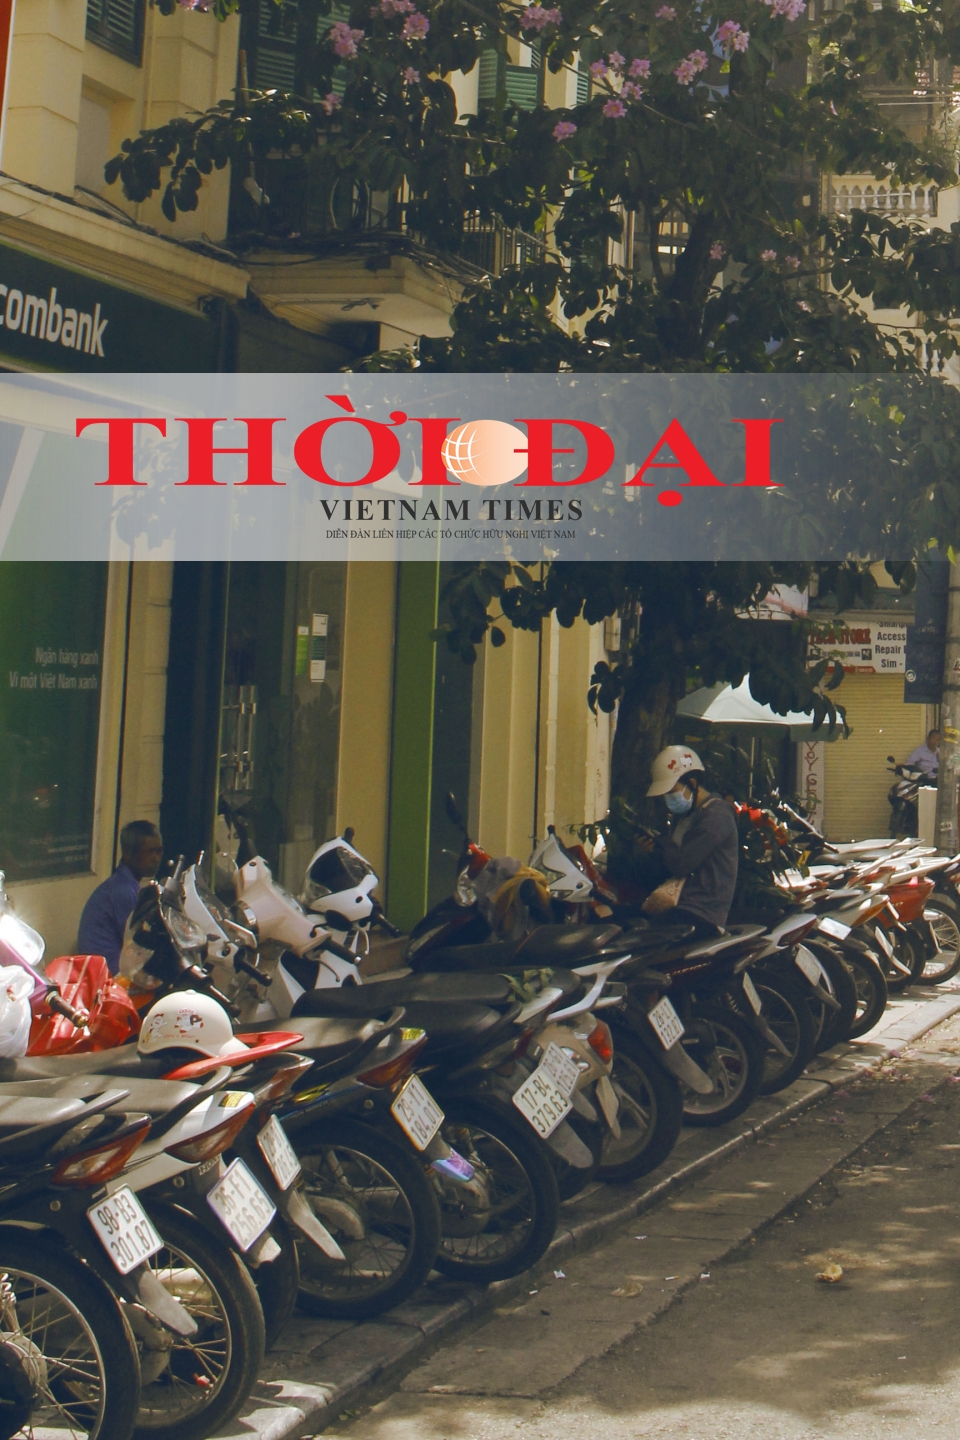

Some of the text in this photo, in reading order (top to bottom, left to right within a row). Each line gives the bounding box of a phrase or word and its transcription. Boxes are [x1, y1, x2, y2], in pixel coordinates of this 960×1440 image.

[875, 645, 901, 655] Repair
[881, 659, 897, 668] Sim
[410, 1100, 440, 1145] 184.01
[532, 1090, 568, 1133] 379.63
[97, 1193, 137, 1235] 98-B3
[110, 1219, 156, 1268] 301.87
